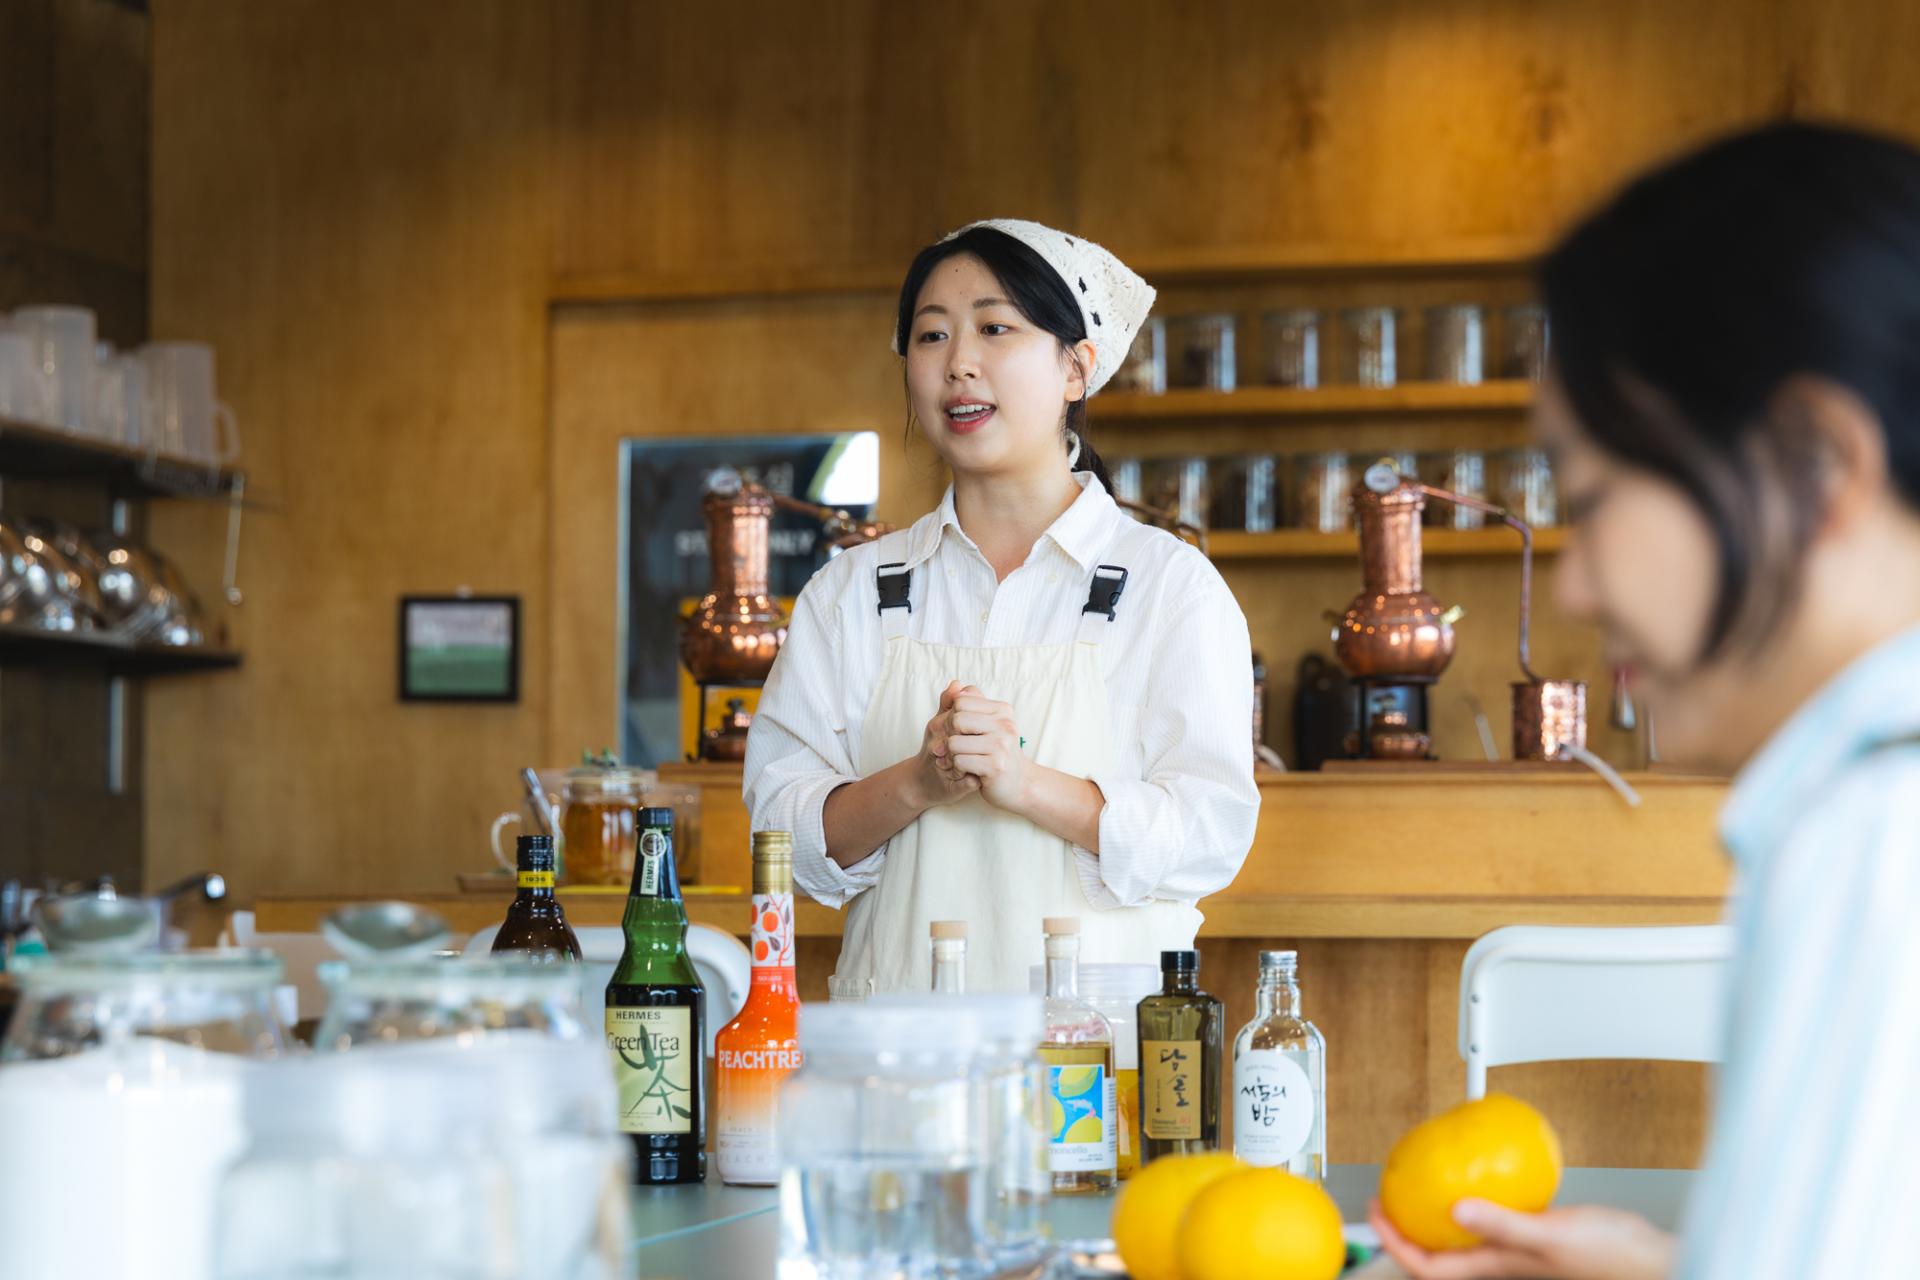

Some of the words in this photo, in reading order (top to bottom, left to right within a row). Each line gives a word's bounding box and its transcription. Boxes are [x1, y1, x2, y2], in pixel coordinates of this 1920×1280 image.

[646, 860, 655, 889] HERMES
[615, 1010, 661, 1020] HERMES
[607, 1032, 647, 1051] Green
[648, 1032, 680, 1051] Tea
[719, 1049, 803, 1069] PEACHTRE
[1240, 1075, 1287, 1102] 서울의
[1251, 1103, 1280, 1126] 밤
